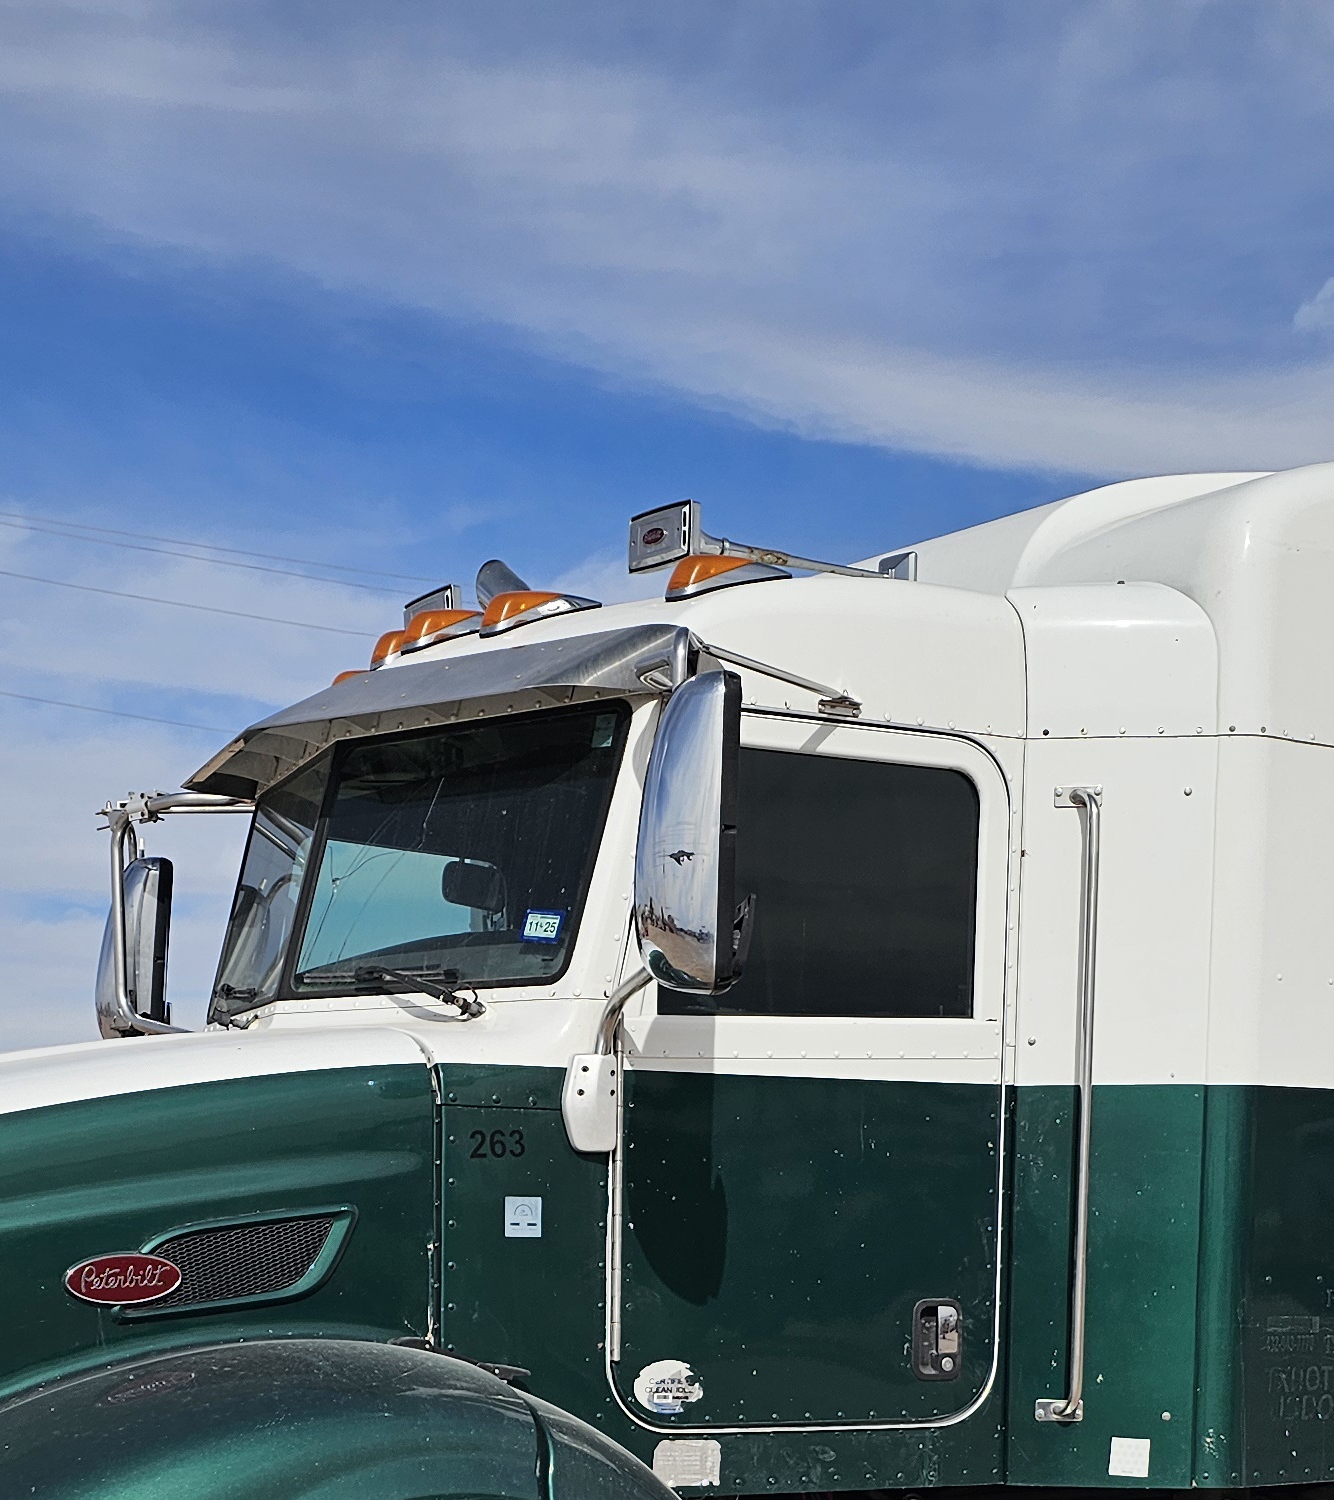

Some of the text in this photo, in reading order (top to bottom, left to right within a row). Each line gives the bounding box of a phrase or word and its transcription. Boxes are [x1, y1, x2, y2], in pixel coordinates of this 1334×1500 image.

[543, 921, 557, 933] 25
[469, 1129, 526, 1159] 263
[80, 1264, 170, 1293] Peterbilt
